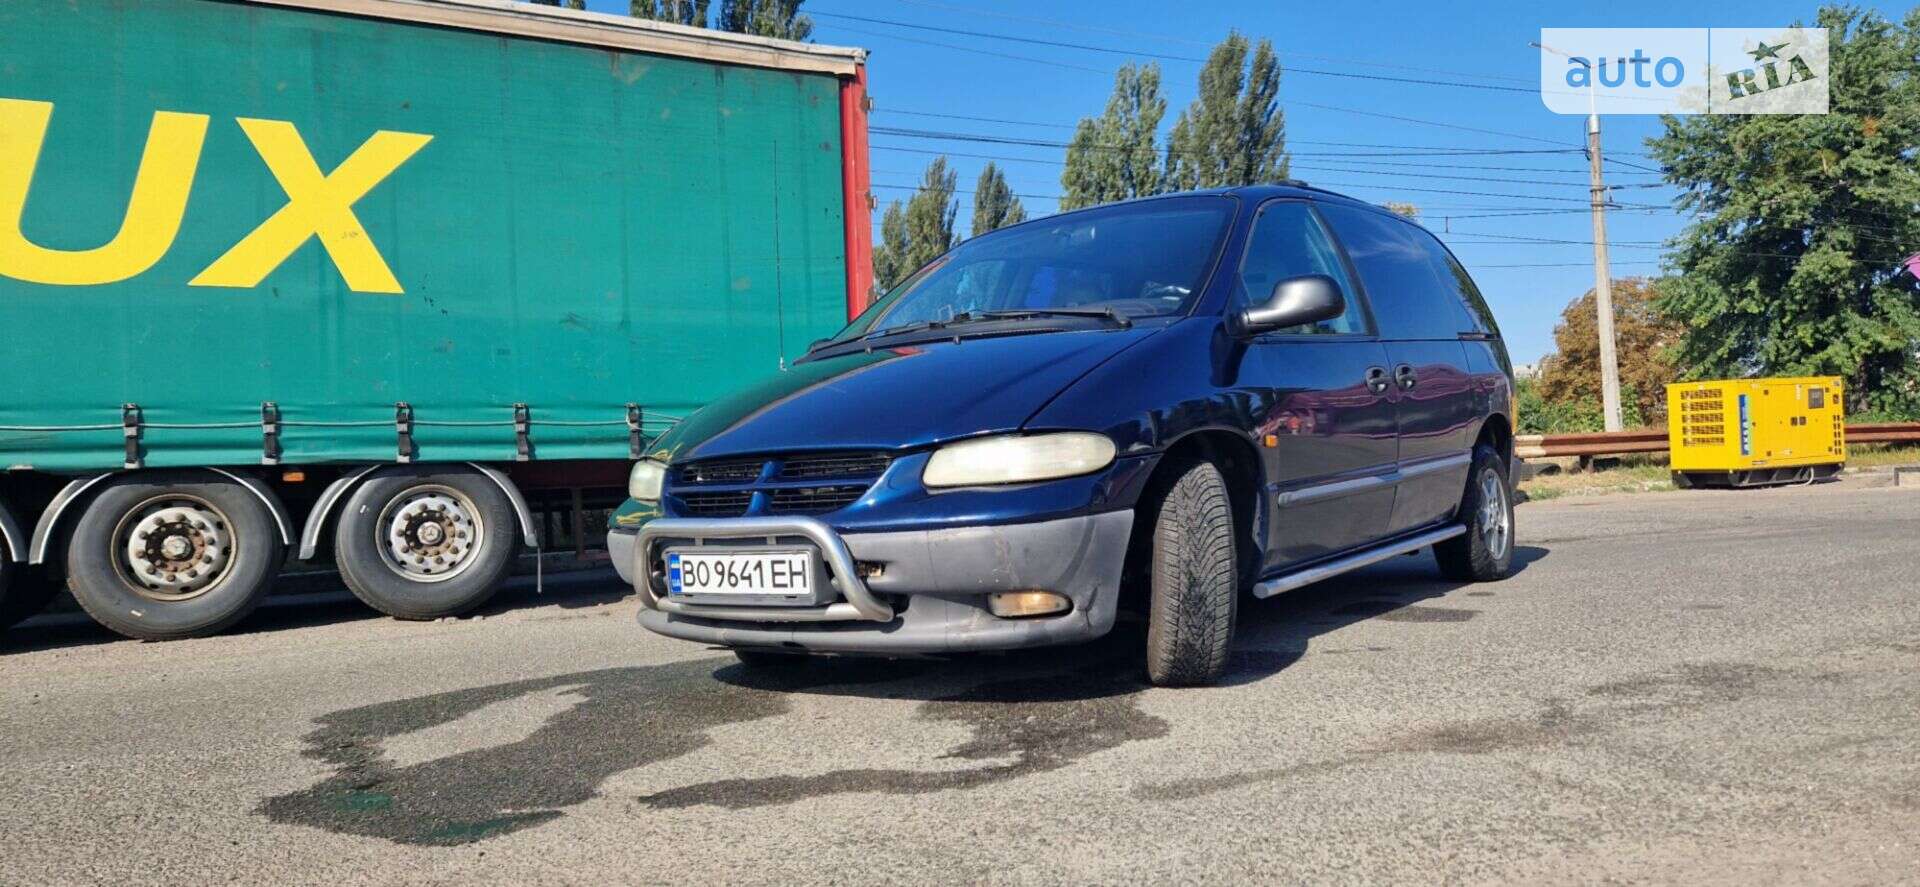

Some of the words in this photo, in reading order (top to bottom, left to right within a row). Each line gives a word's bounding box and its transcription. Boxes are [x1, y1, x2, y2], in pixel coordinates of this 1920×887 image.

[0, 98, 434, 293] UX
[682, 560, 710, 587] BO
[714, 560, 764, 588] 9641
[771, 560, 807, 588] EH
